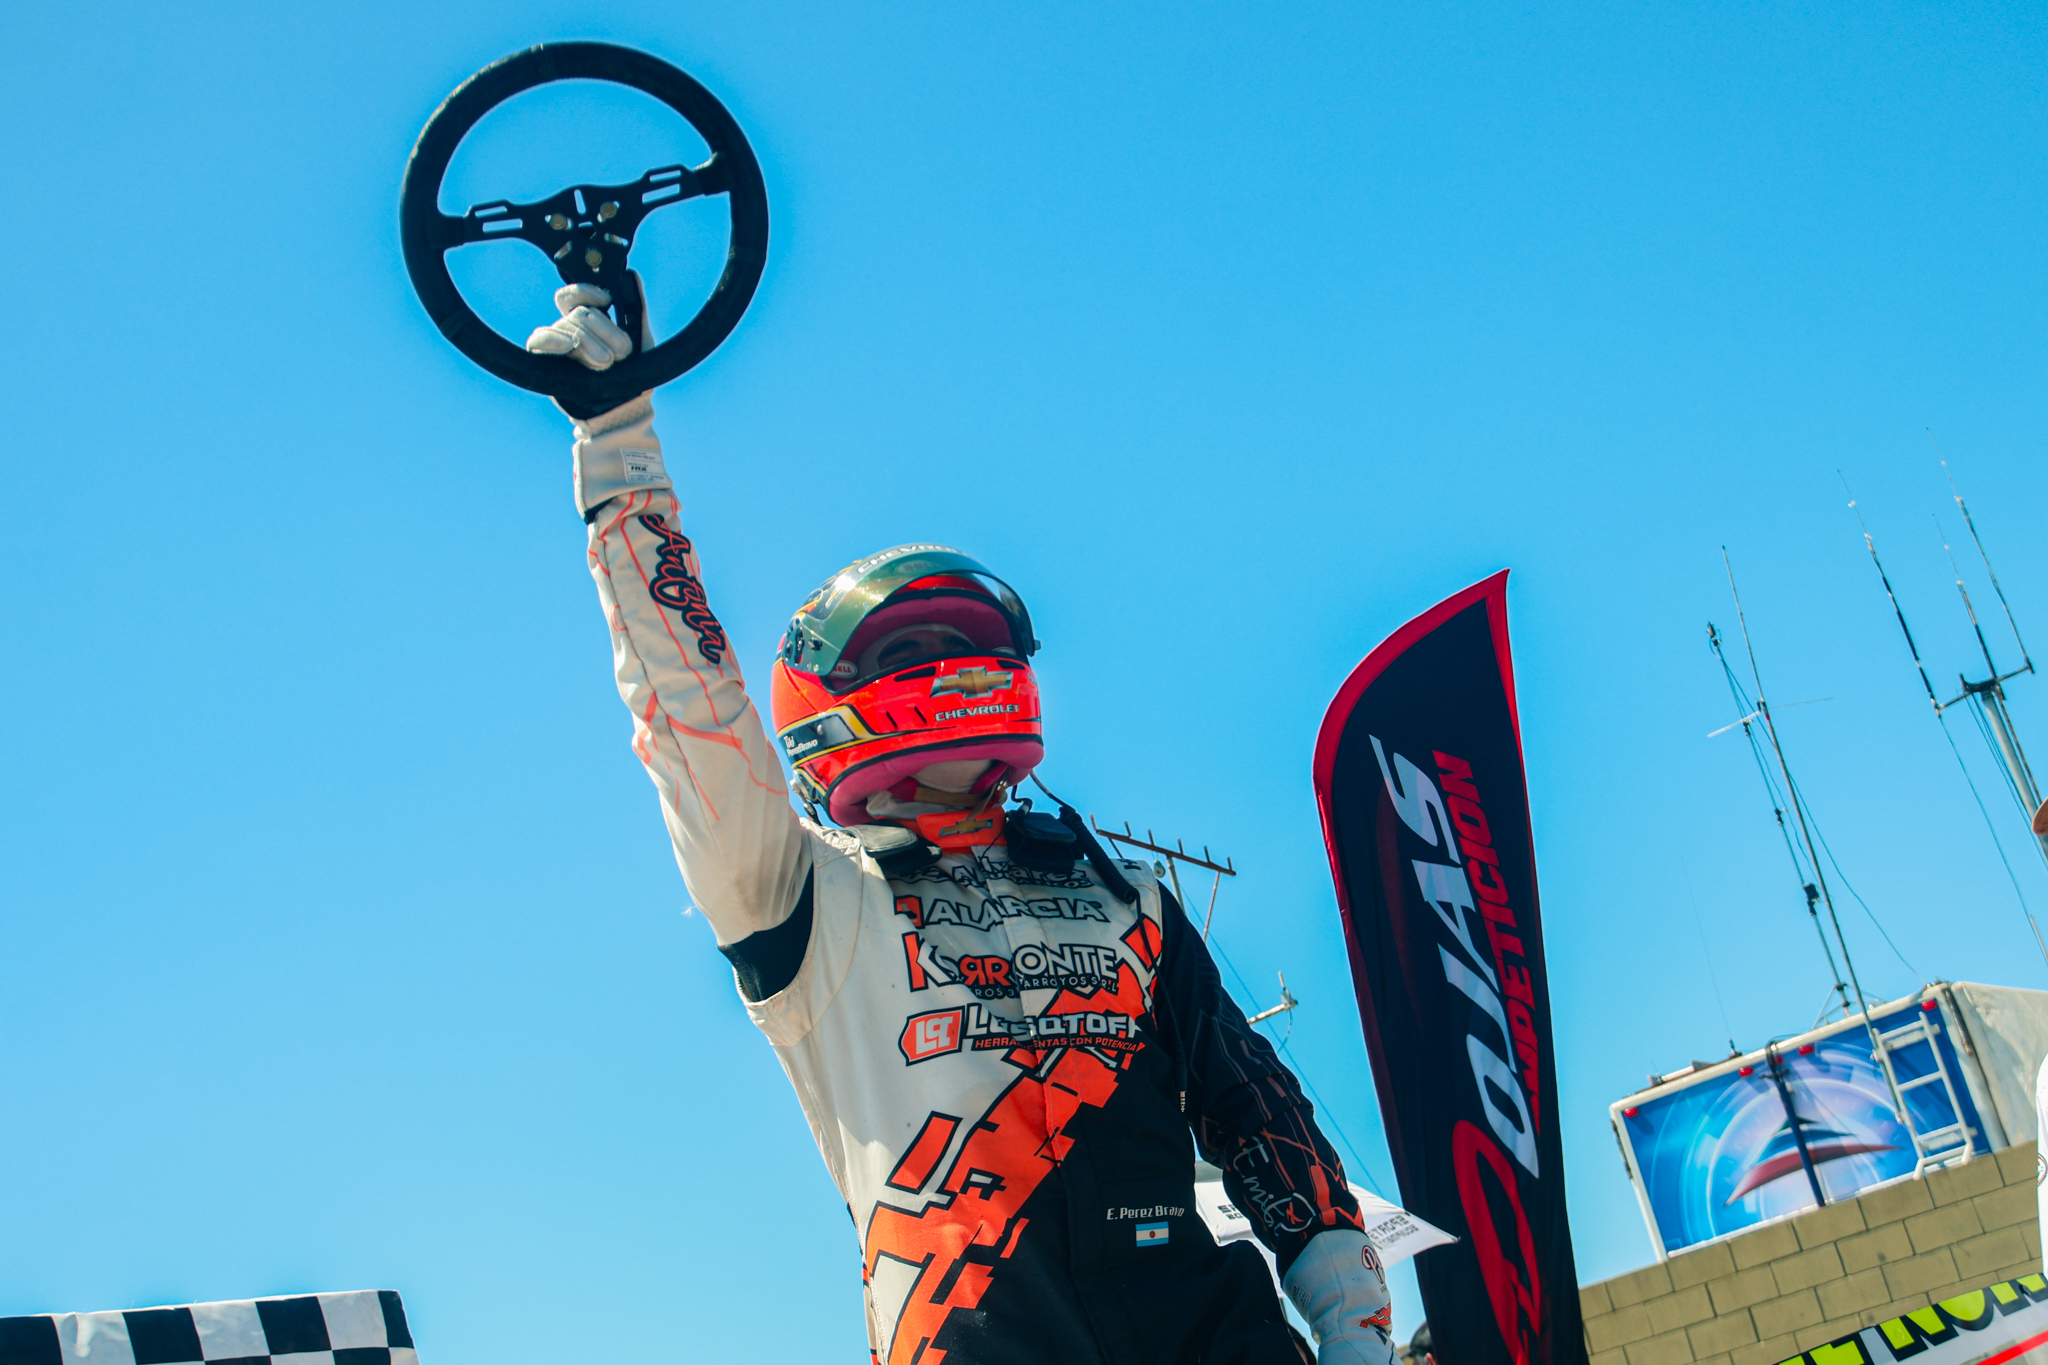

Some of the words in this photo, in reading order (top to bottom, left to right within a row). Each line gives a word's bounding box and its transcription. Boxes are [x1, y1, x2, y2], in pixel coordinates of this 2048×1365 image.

[935, 704, 1020, 722] CHEVROLET
[925, 895, 1110, 931] ALARCIA
[1095, 1037, 1136, 1052] POTENCIA
[1106, 1208, 1118, 1220] E.
[1119, 1207, 1153, 1219] Perez
[1155, 1205, 1185, 1217] Bravo
